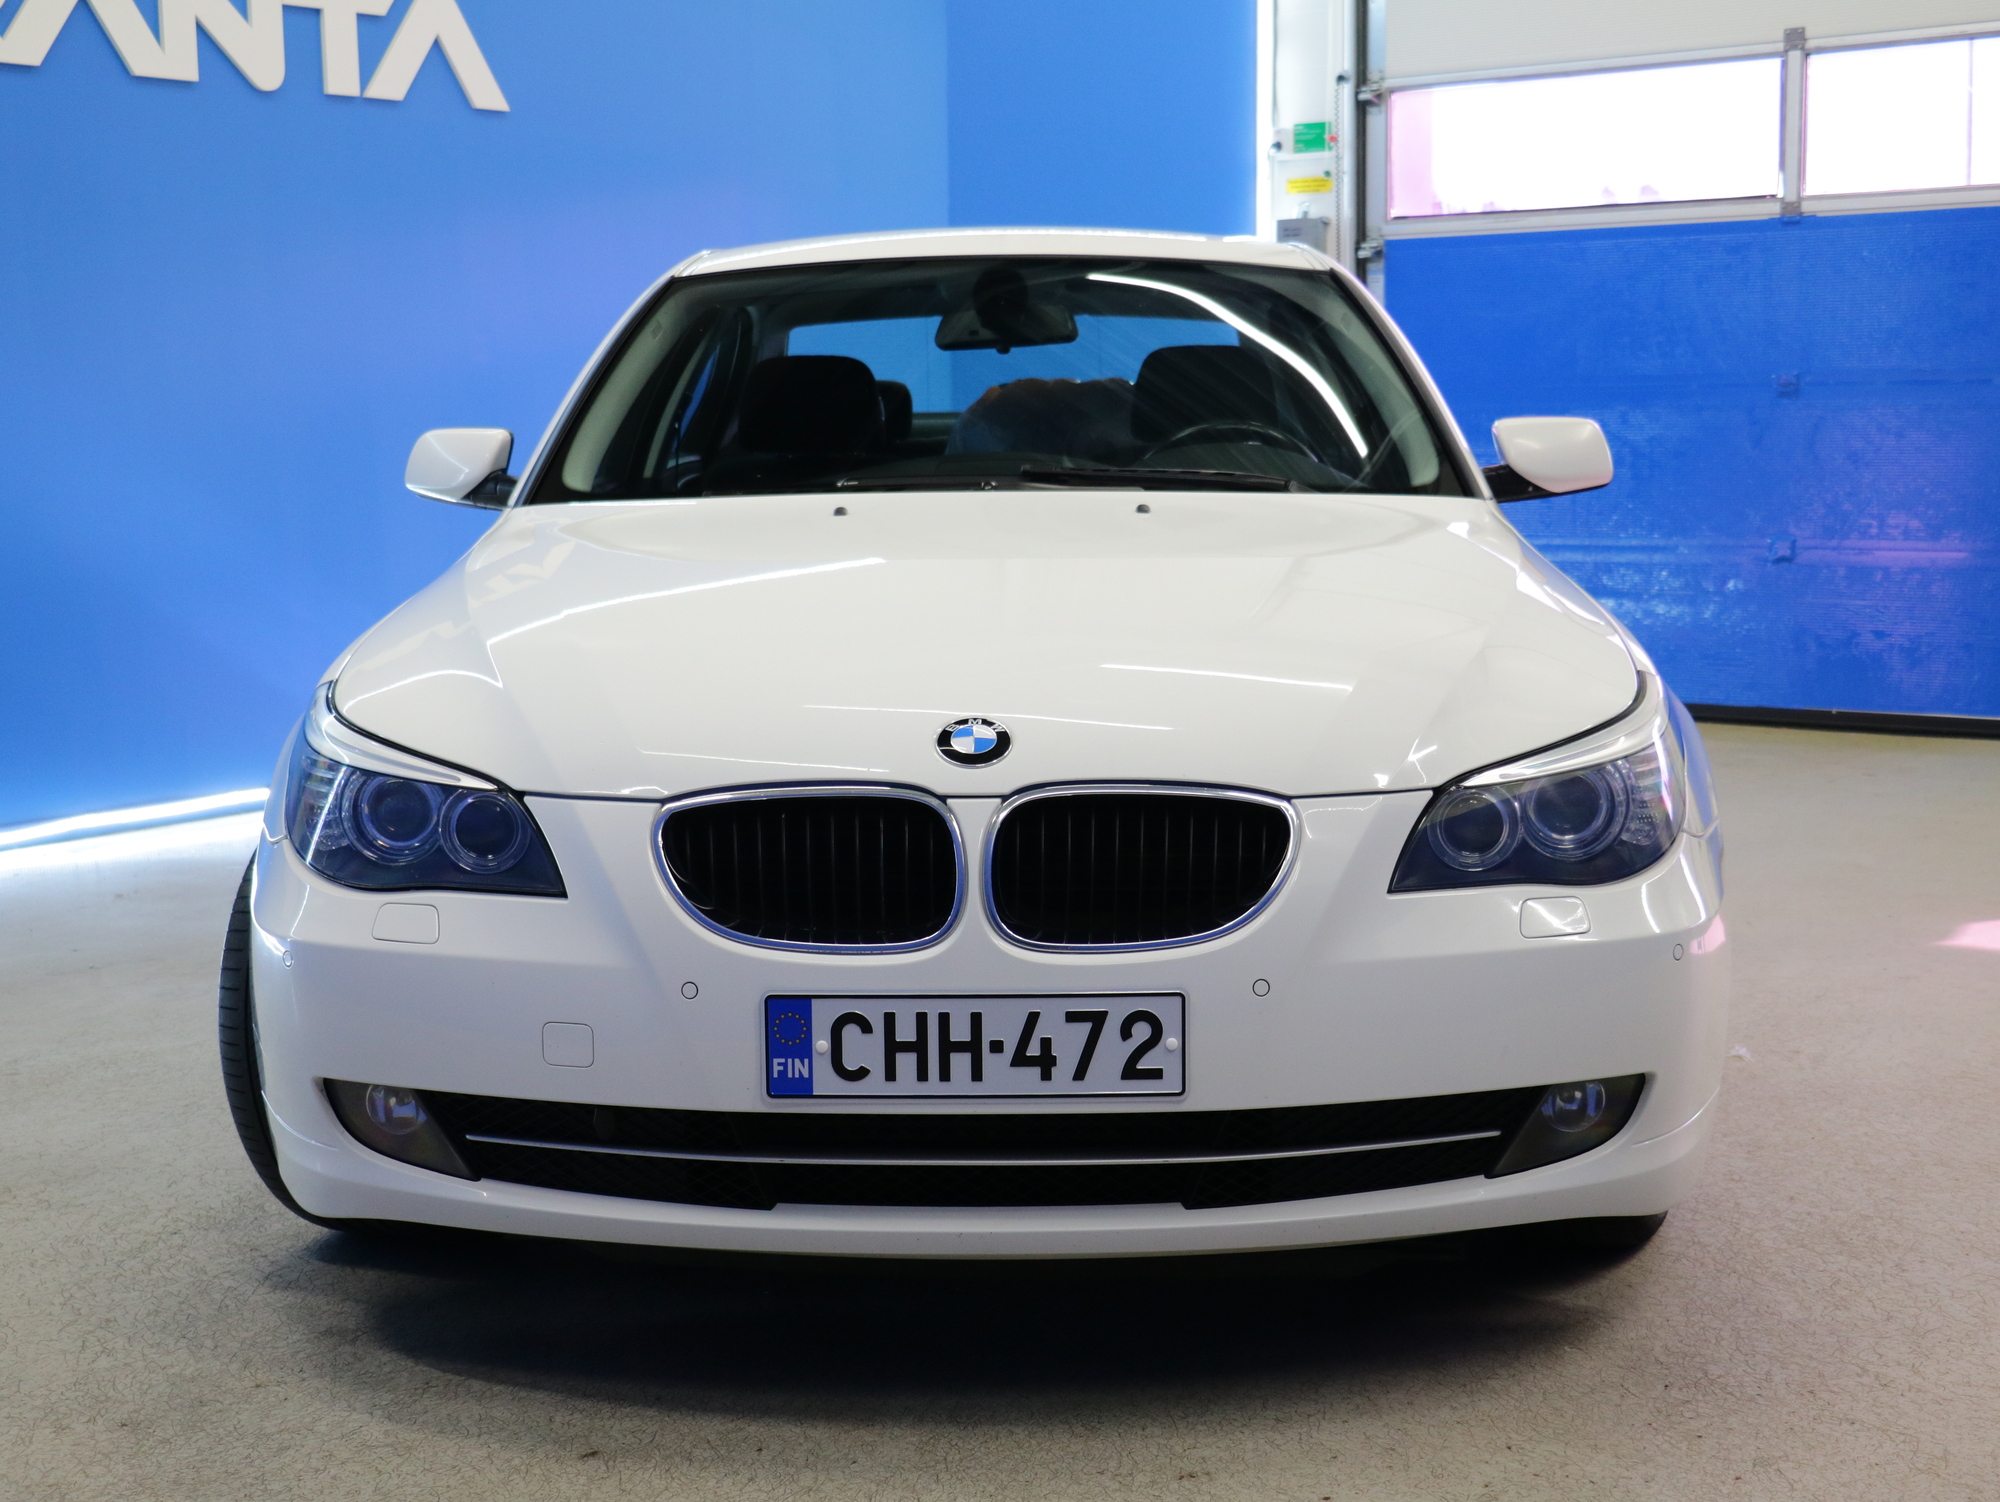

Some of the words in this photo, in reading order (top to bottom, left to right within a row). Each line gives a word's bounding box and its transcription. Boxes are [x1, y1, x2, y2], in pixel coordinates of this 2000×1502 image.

[945, 718, 1006, 732] BMW
[830, 1009, 1164, 1082] CHH-472
[772, 1058, 809, 1079] FIN
